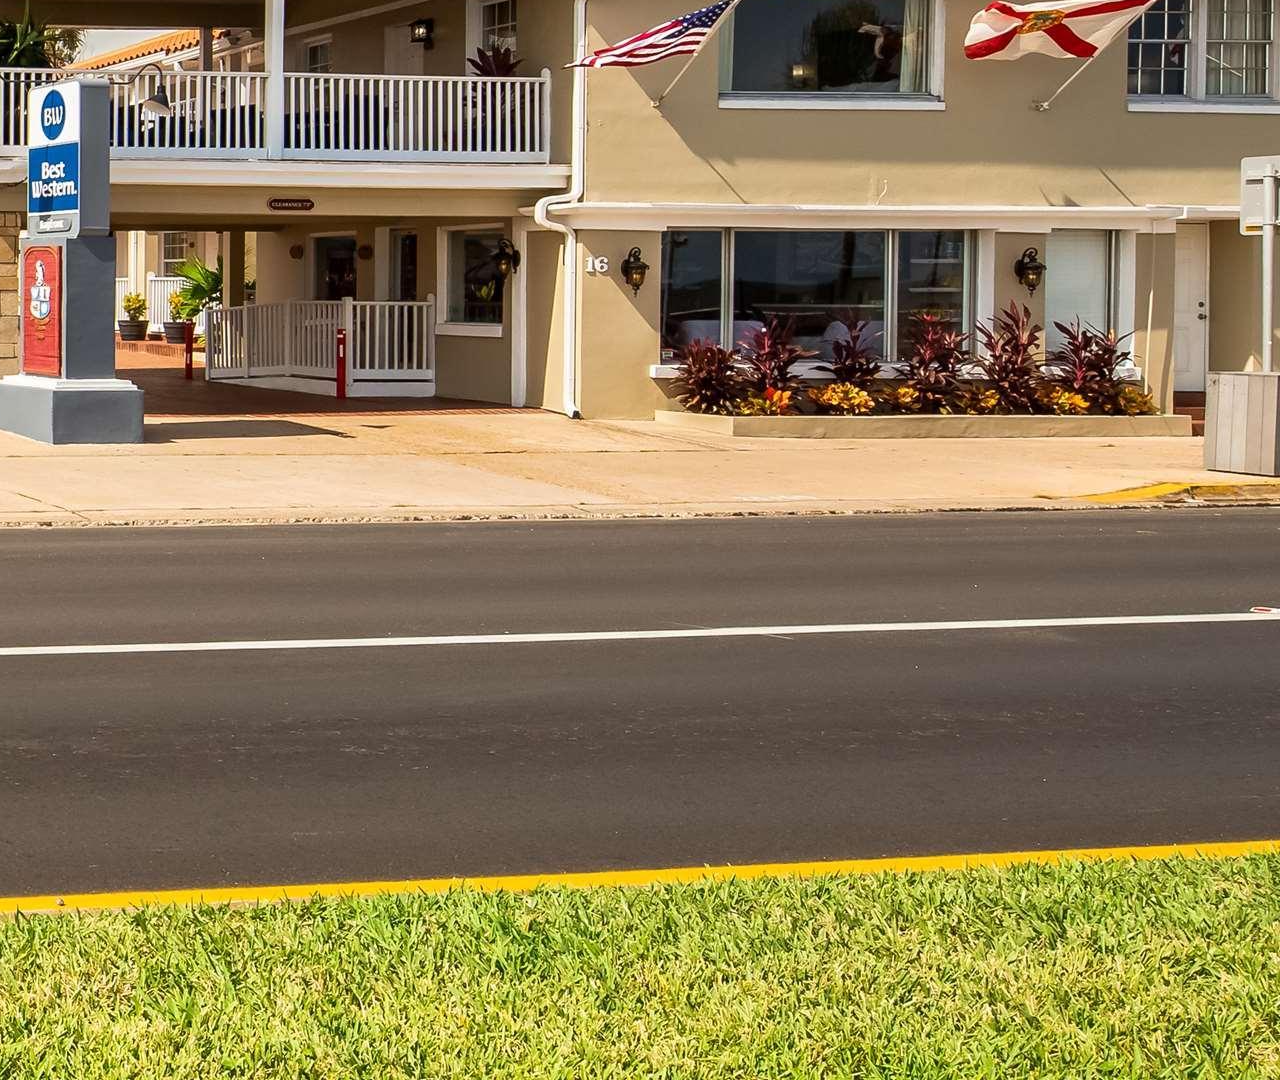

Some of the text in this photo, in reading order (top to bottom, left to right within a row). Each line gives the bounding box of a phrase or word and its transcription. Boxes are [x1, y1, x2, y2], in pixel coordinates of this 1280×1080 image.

[43, 105, 64, 127] BW
[41, 161, 65, 179] Best
[585, 256, 609, 273] 16
